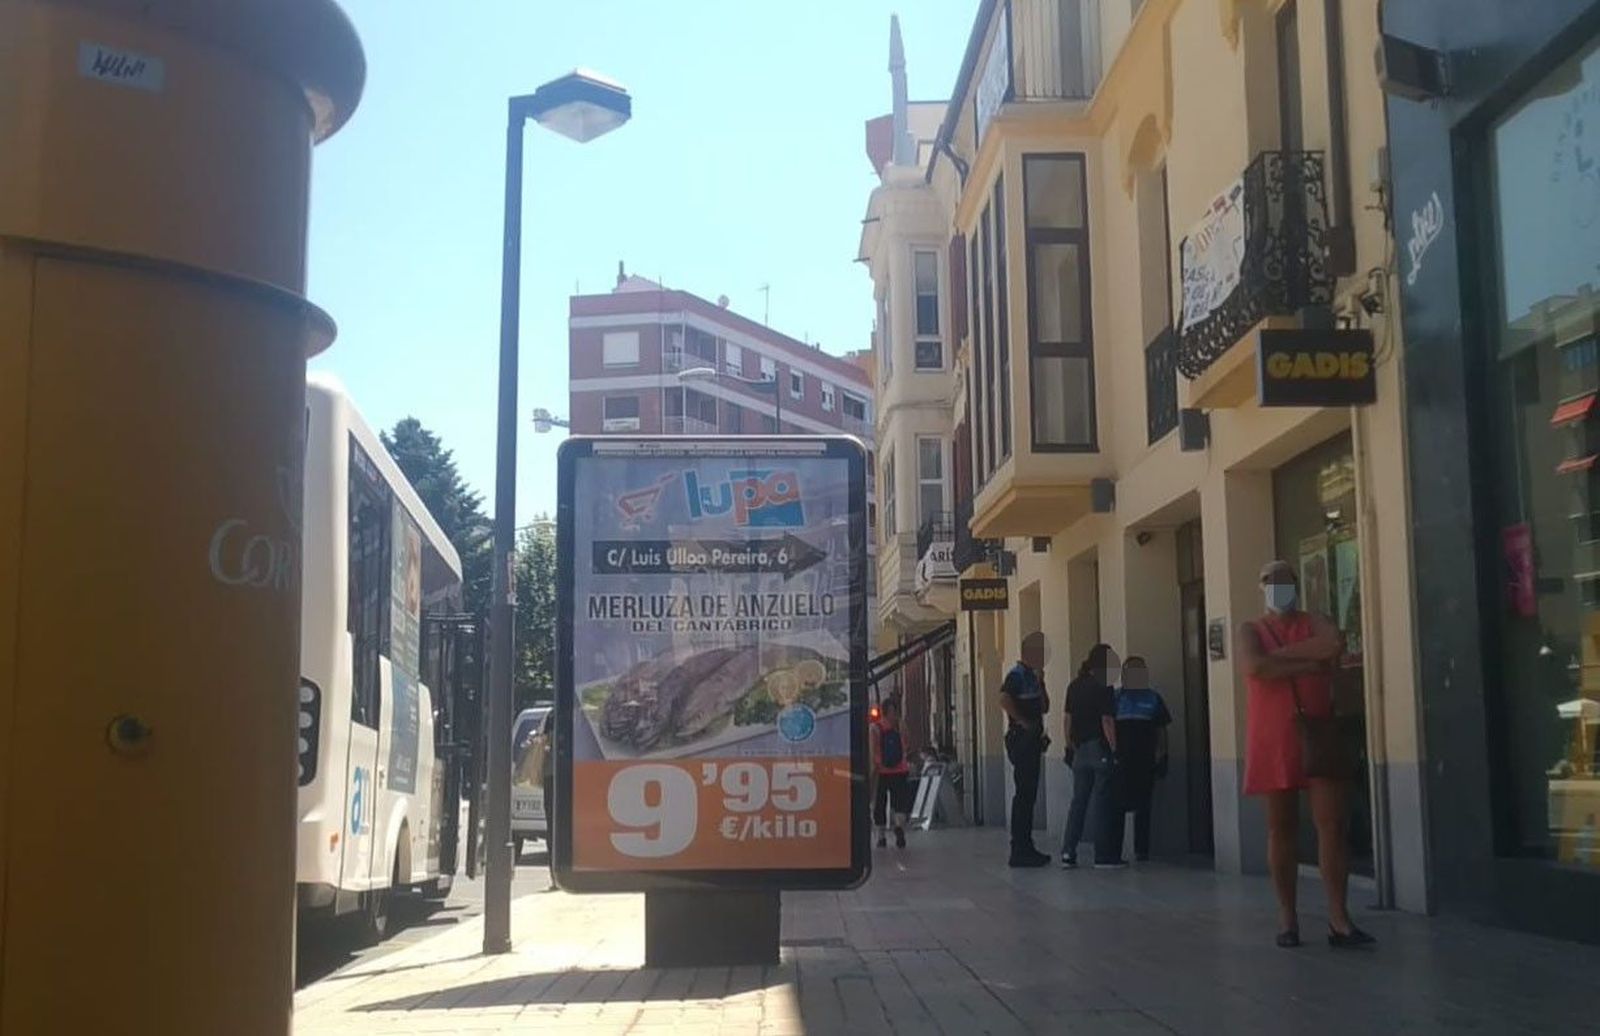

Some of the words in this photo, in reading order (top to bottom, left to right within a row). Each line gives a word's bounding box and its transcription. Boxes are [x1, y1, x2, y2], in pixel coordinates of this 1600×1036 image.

[1267, 353, 1370, 379] GADIS
[683, 468, 801, 526] lupa
[607, 548, 626, 567] C/
[632, 549, 661, 566] Luis
[666, 548, 706, 566] Ulloa
[712, 547, 773, 567] Pereira,
[777, 547, 789, 564] 6
[588, 595, 694, 620] MERLUZA
[701, 595, 729, 618] DE
[735, 592, 835, 618] ANZUELO
[963, 588, 1007, 600] GADIS
[632, 621, 665, 633] DEL
[721, 816, 817, 841] €/kilo
